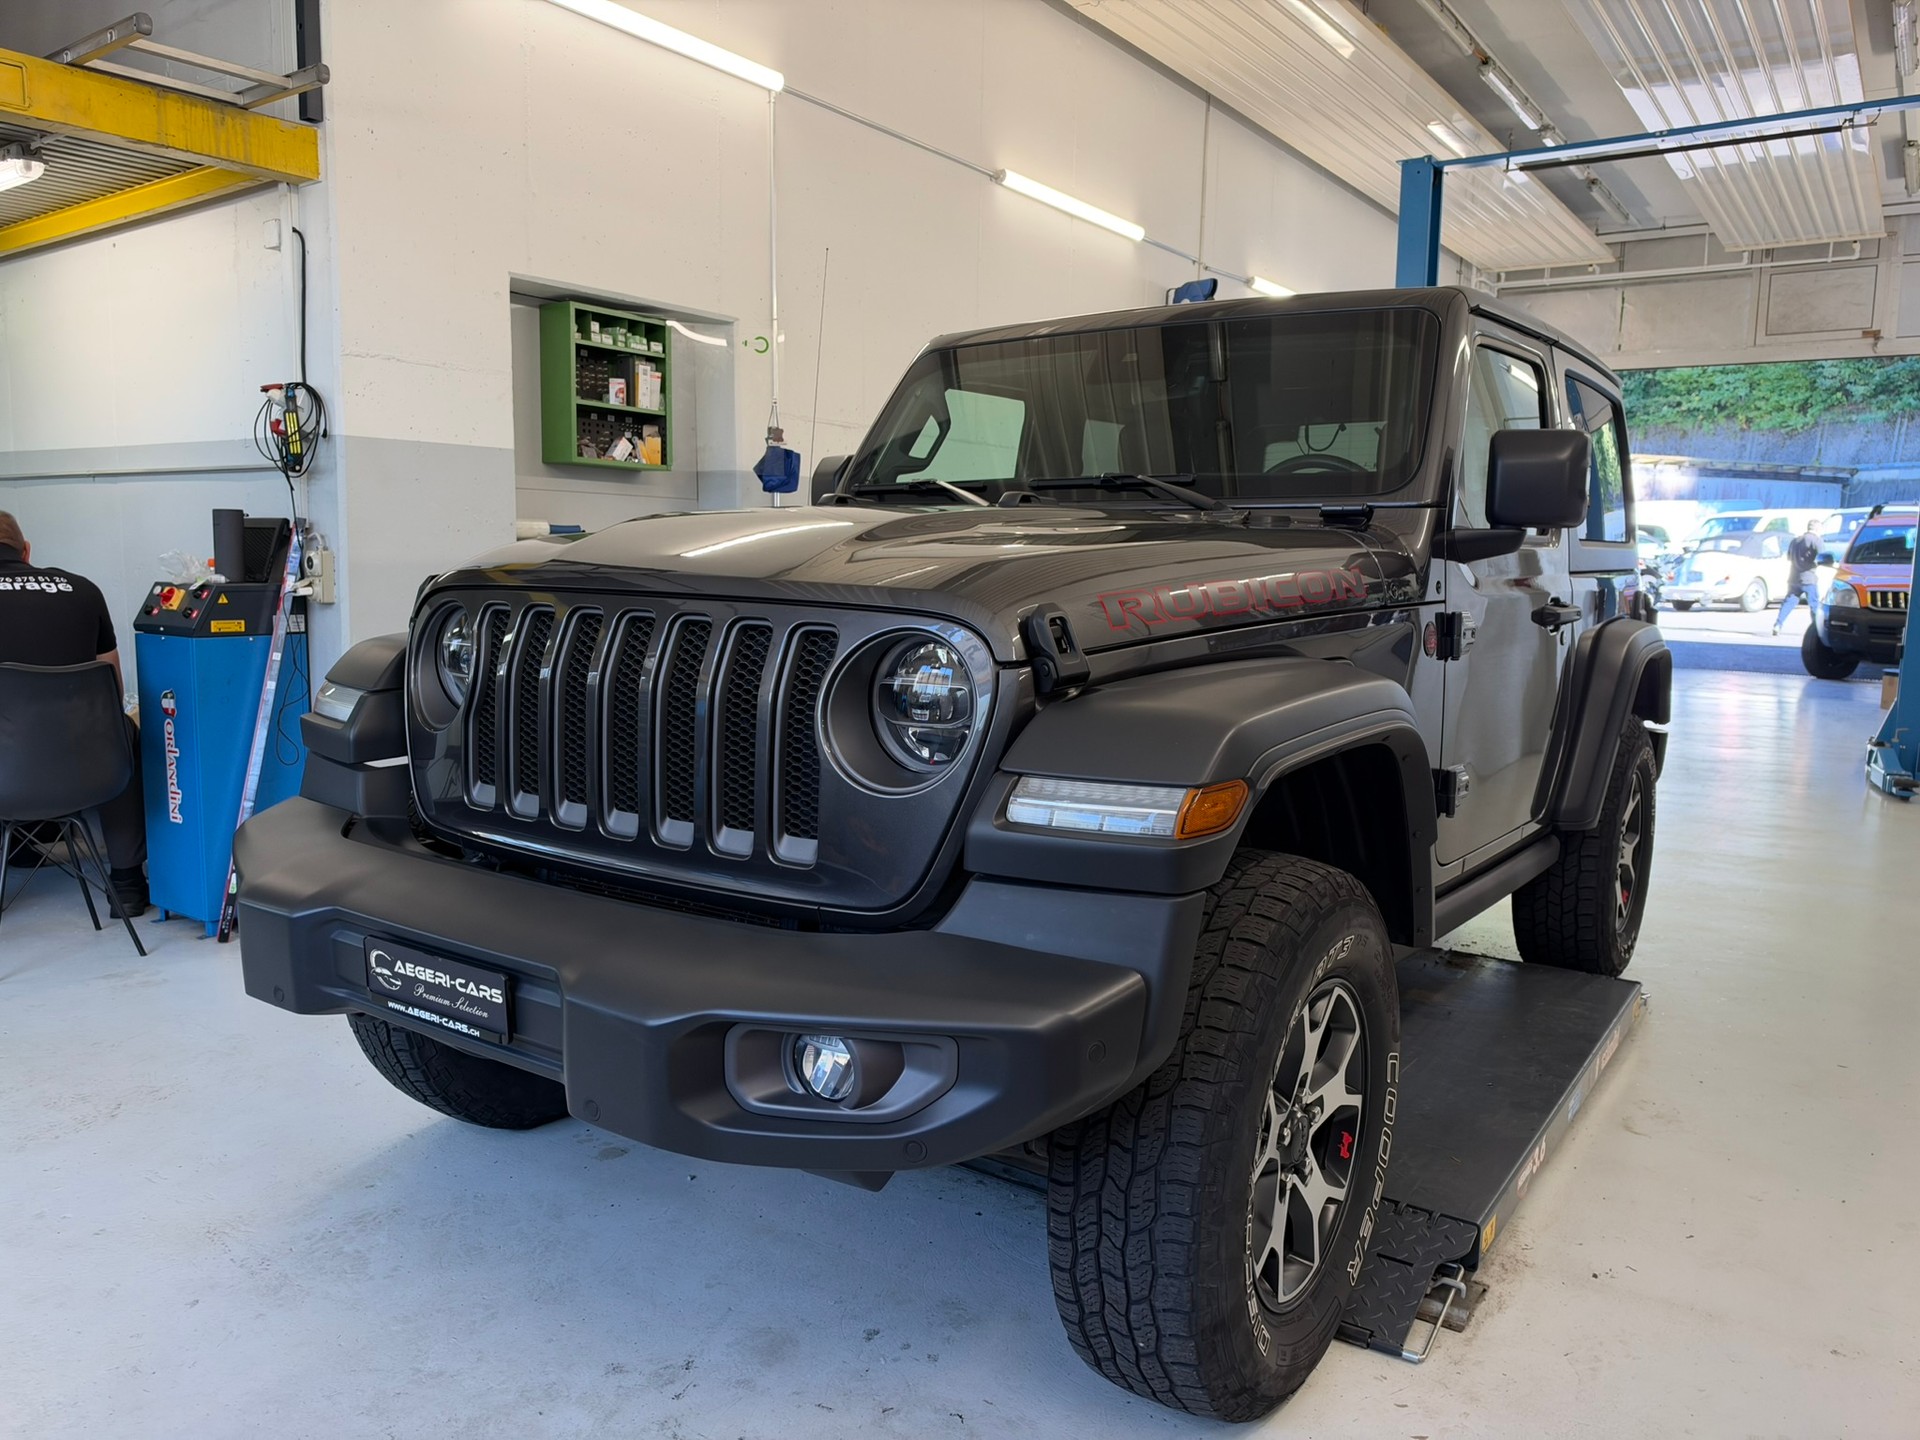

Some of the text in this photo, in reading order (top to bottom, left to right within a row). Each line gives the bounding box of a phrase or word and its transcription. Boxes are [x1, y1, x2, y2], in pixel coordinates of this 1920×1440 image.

[1097, 568, 1369, 631] RUBICON
[394, 960, 503, 1004] AEGERI-CARS
[413, 982, 489, 1019] Premium Selection
[1347, 1052, 1399, 1286] COOPER
